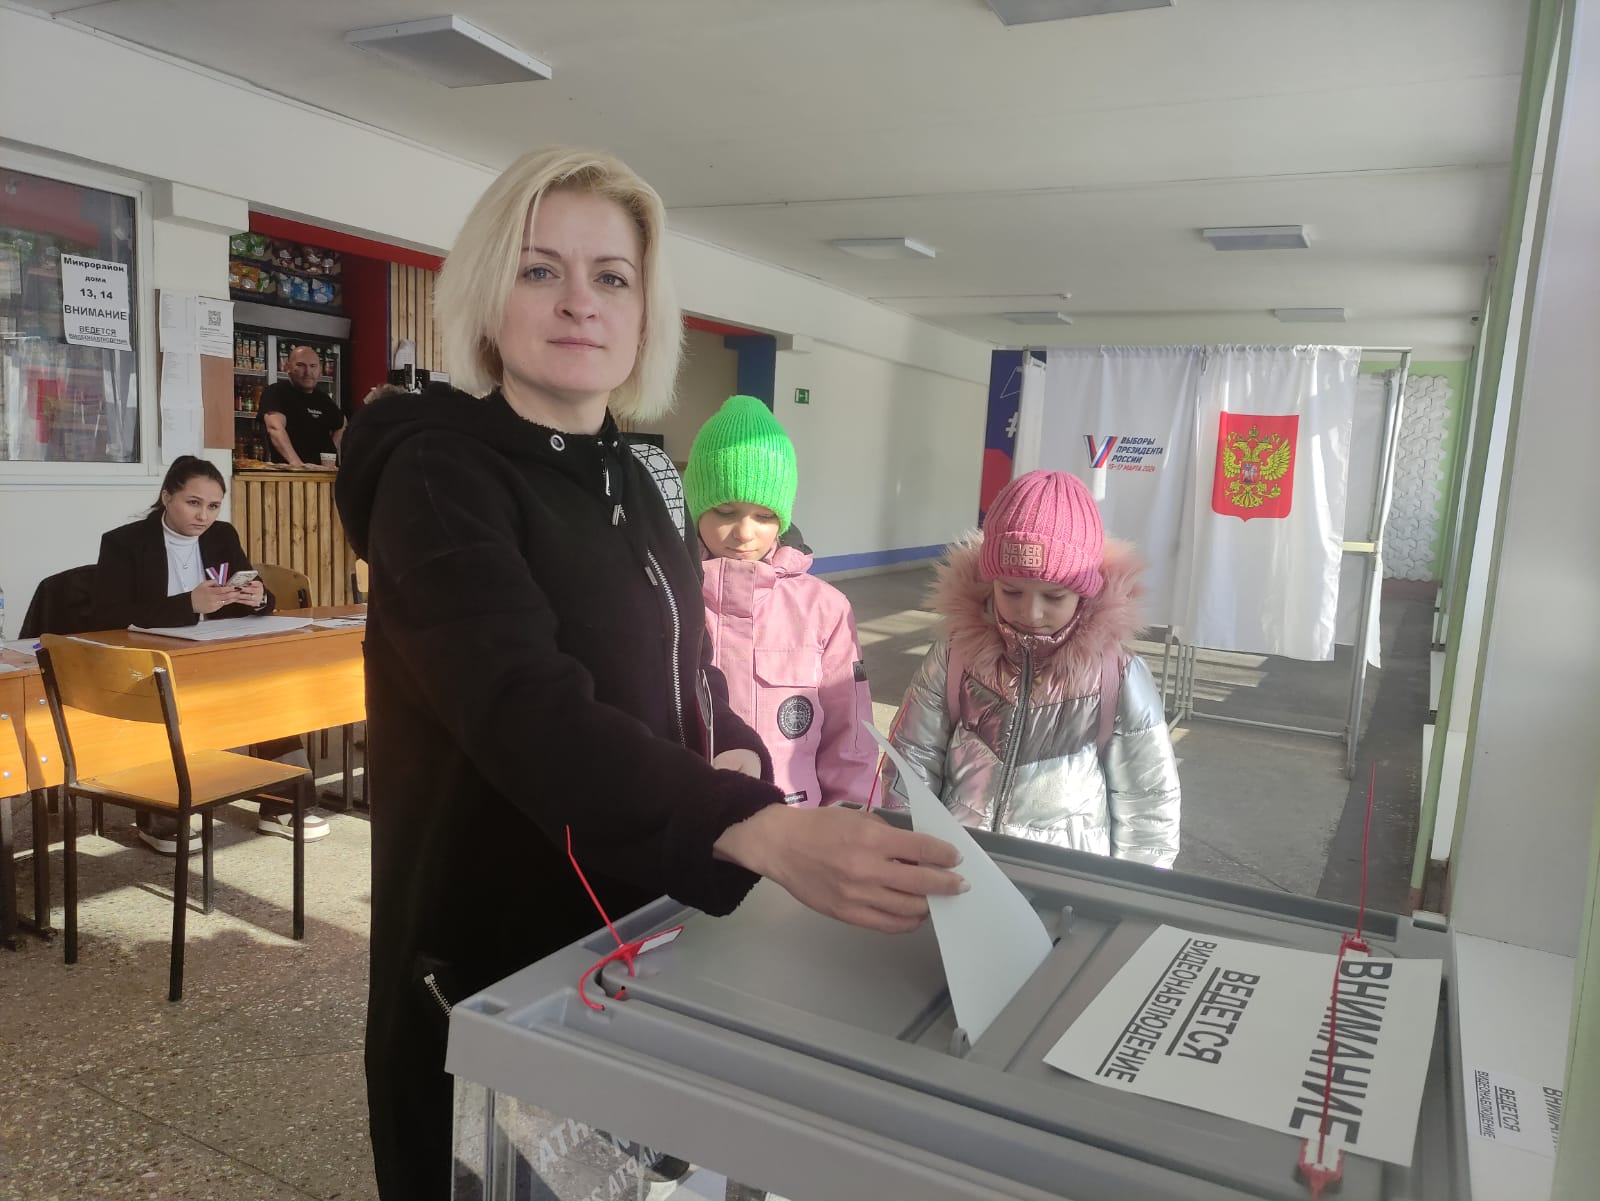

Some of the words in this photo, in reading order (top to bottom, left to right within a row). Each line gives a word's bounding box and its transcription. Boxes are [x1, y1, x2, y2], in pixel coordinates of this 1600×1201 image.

[63, 257, 125, 272] Микрорайон
[80, 288, 97, 299] 13,
[100, 291, 113, 299] 14
[64, 304, 127, 320] ВНИМАНИЕ
[79, 325, 117, 336] ВЕДЕТСЯ
[1120, 436, 1156, 446] ВЫБОРЫ
[1116, 446, 1164, 456] ПРЕЗИДЕНТА
[1111, 455, 1143, 464] РОССИИ
[1003, 543, 1042, 557] NEVER
[1003, 554, 1042, 568] BORED
[1103, 939, 1218, 1083] ВИДЕОНАБЛЮДЕНИЕ
[1177, 969, 1261, 1064] ВЕДЕТСЯ
[1289, 960, 1393, 1144] ВНИМАНИЕ
[1499, 1087, 1520, 1133] ВЕДЕТСЯ
